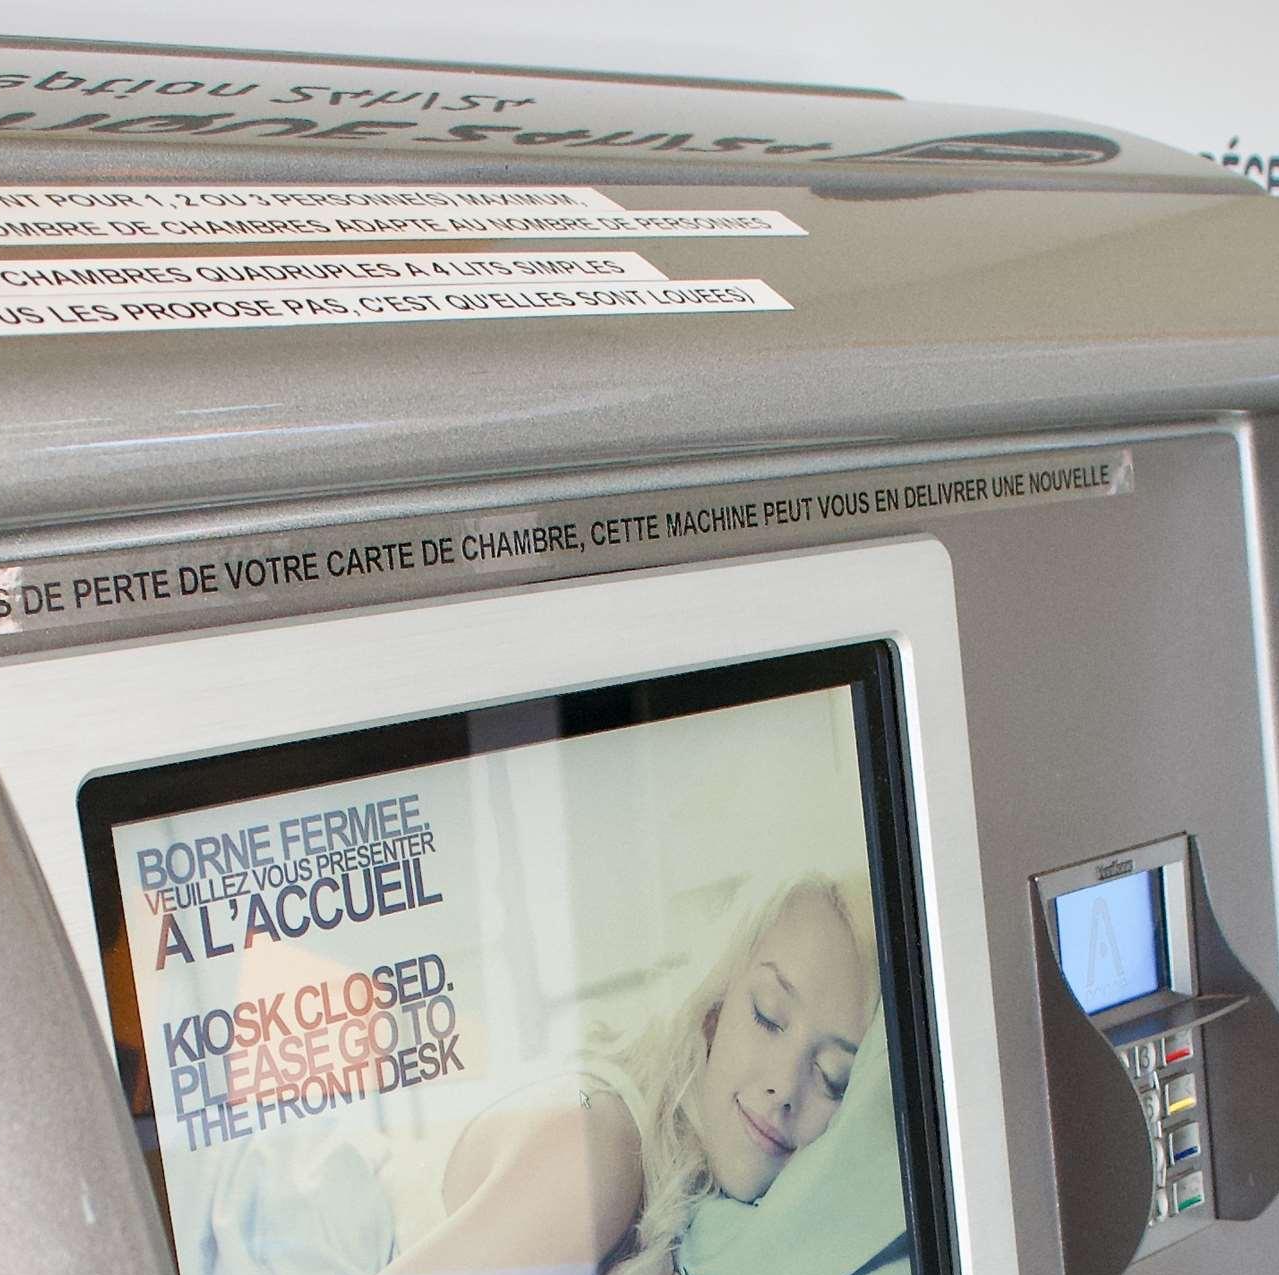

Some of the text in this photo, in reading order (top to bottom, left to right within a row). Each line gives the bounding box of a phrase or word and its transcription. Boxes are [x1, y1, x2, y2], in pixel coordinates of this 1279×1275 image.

[48, 193, 142, 208] POUR
[175, 194, 200, 207] 2
[200, 194, 247, 207] OU
[249, 194, 271, 206] 3
[271, 192, 459, 207] PERSONNE(S)
[109, 220, 159, 236] DE
[161, 219, 329, 236] CHAMBRES
[337, 218, 448, 234] ADAPTE
[448, 217, 488, 232] AU
[488, 217, 600, 231] NOMBRE
[597, 217, 632, 231] DE
[635, 216, 773, 230] PERSONNES
[0, 266, 193, 287] CHAMBRES
[196, 263, 401, 283] QUADRUPLES
[406, 263, 433, 278] A
[433, 263, 453, 278] 4
[454, 261, 513, 277] LITS
[515, 259, 625, 275] SIMPLES
[47, 304, 120, 323] LES
[117, 300, 283, 321] PROPOSE
[284, 298, 361, 319] PAS,
[359, 294, 444, 314] C'EST
[445, 290, 580, 312] QU'ELLES
[573, 289, 653, 307] SONT
[652, 286, 756, 306] LOUEES)
[22, 585, 65, 616] DE
[72, 569, 171, 610] PERTE
[178, 563, 219, 597] DE
[224, 552, 320, 592] VOTRE
[326, 541, 415, 578] CARTE
[421, 536, 456, 567] DE
[461, 522, 585, 562] CHAMBRE,
[590, 515, 661, 546] CETTE
[667, 503, 759, 538] MACHINE
[764, 496, 813, 527] PEUT
[817, 490, 871, 520] VOUS
[875, 486, 901, 512] EN
[905, 478, 989, 510] DELIVRER
[992, 471, 1026, 498] UNE
[1029, 464, 1111, 494] NOUVELLE
[137, 825, 274, 892] BORNE
[144, 831, 437, 916] VEUILLEZ VOUS PRESENTER
[155, 858, 444, 971] A L'ACCUEIL
[163, 953, 455, 1068] KIOSK CLOSED.
[170, 994, 457, 1115] PLEASE GO TO
[177, 1034, 466, 1153] THE FRONT DESK
